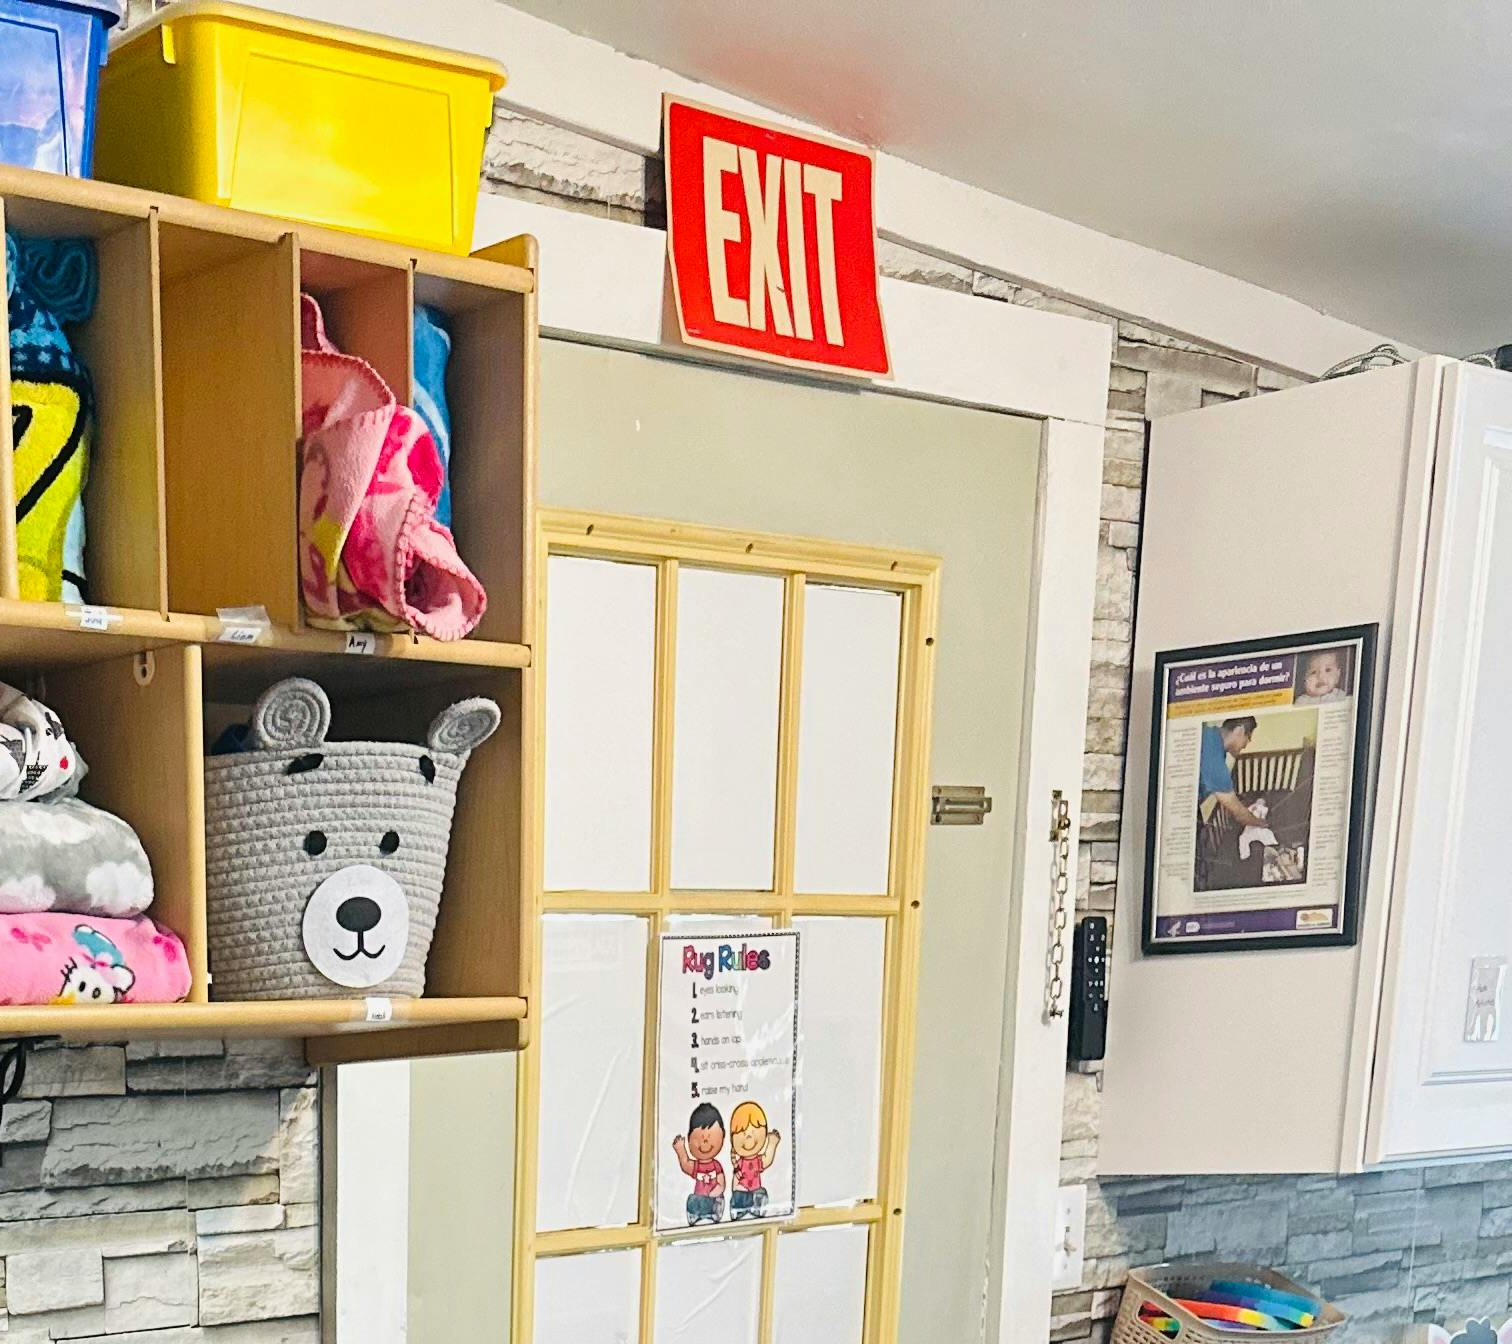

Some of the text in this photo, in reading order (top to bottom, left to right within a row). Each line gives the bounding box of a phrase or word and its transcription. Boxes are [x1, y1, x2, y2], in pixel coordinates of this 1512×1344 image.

[703, 136, 844, 347] EXIT
[348, 636, 368, 653] Amy
[1175, 671, 1291, 697] ambiente seguro para dormir?
[1197, 671, 1207, 681] es
[1207, 669, 1217, 679] la
[1217, 664, 1257, 679] apariencia
[1259, 662, 1270, 672] de
[1271, 661, 1283, 670] un
[682, 943, 771, 980] Rug Rules
